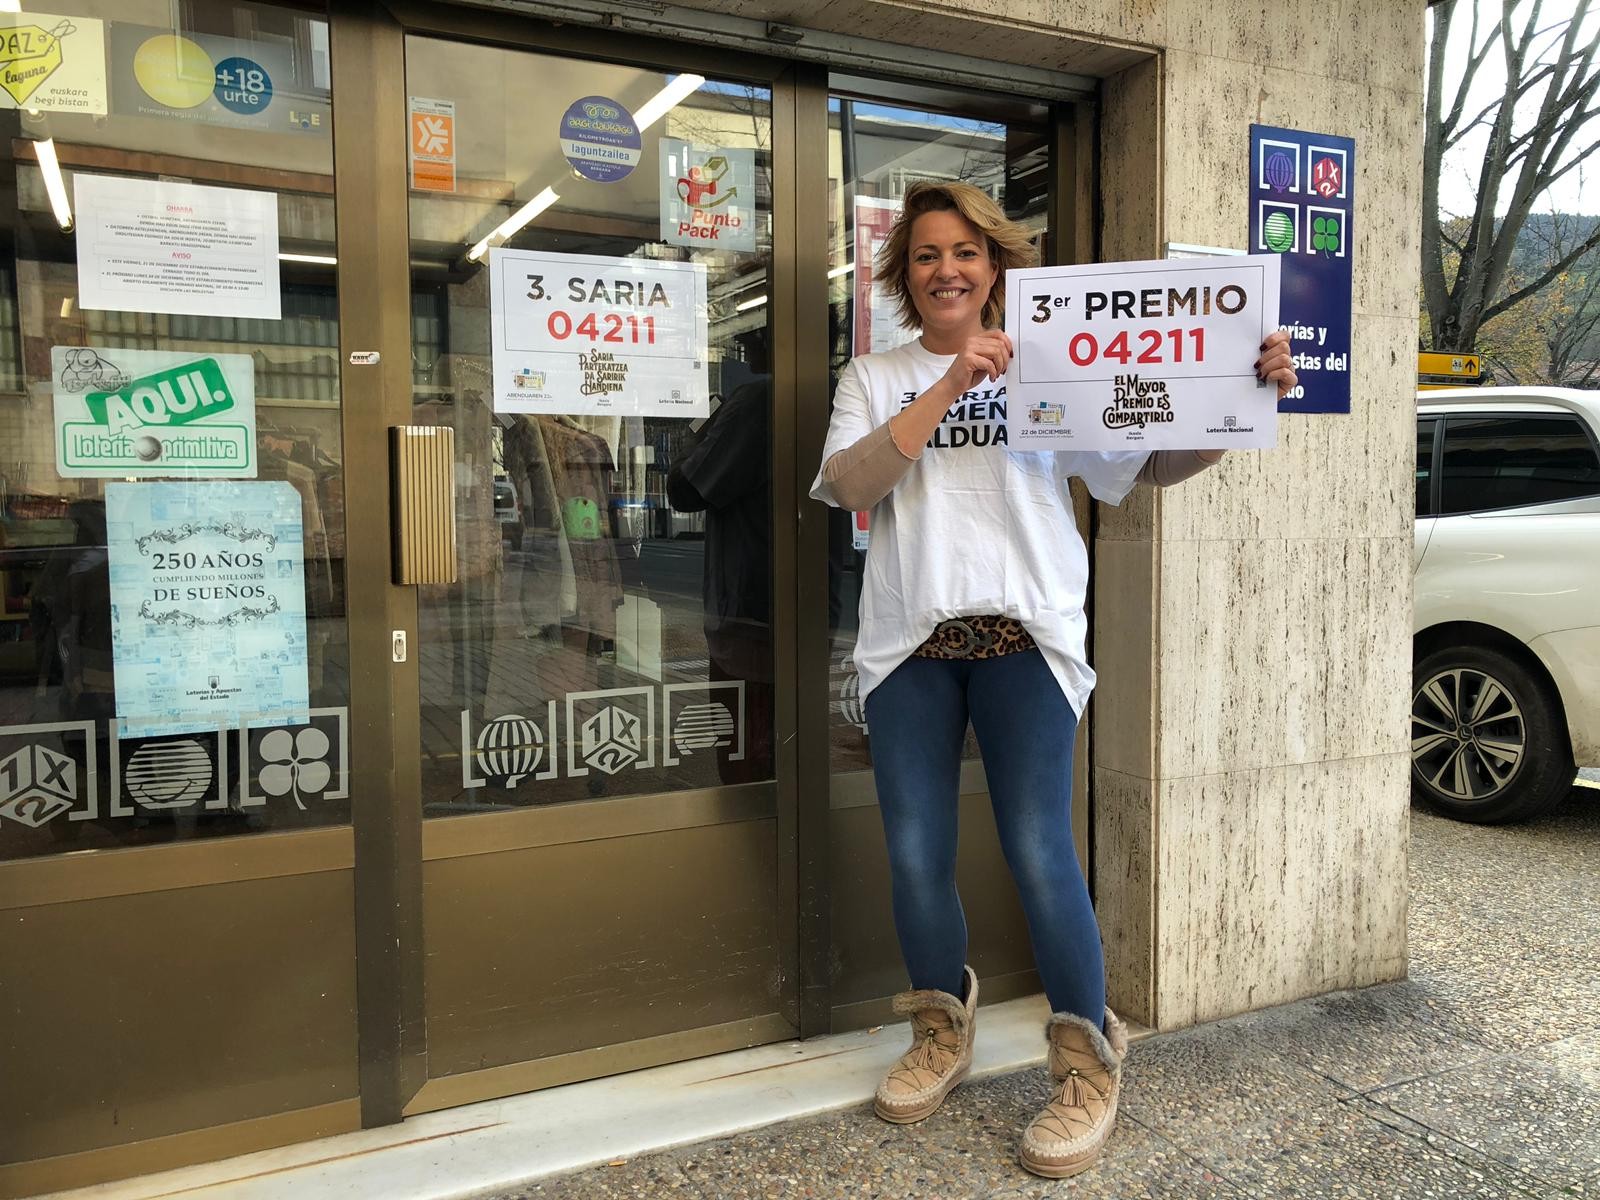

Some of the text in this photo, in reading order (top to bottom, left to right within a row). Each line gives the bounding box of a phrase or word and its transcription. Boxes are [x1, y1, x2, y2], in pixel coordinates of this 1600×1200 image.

[5, 66, 48, 84] laguna
[35, 96, 89, 107] begi bistan
[51, 88, 88, 97] euskara
[224, 89, 259, 105] urte
[572, 144, 630, 161] laguntzailea
[692, 209, 742, 227] Punto
[678, 222, 720, 240] Pack
[527, 274, 672, 308] 3. SARIA
[1085, 285, 1248, 321] PREMIO
[547, 310, 655, 345] 04211
[1319, 328, 1327, 346] y
[1069, 328, 1205, 367] 04211
[579, 354, 629, 372] PARTEKATZEA
[1326, 352, 1347, 372] del
[585, 370, 626, 384] DA SARIRIK
[1115, 374, 1167, 398] EL MAYOR
[580, 380, 624, 396] HANDIENA
[955, 386, 1007, 404] RIA
[1113, 387, 1171, 412] PREMIO ES
[1103, 407, 1175, 430] COMPARTIRLO
[927, 425, 1009, 449] LDUA
[161, 436, 238, 463] primitiva
[153, 551, 263, 570] 250 AÑOS
[153, 575, 216, 583] CUMPLIENDO
[154, 584, 265, 602] DE SUEÑOS
